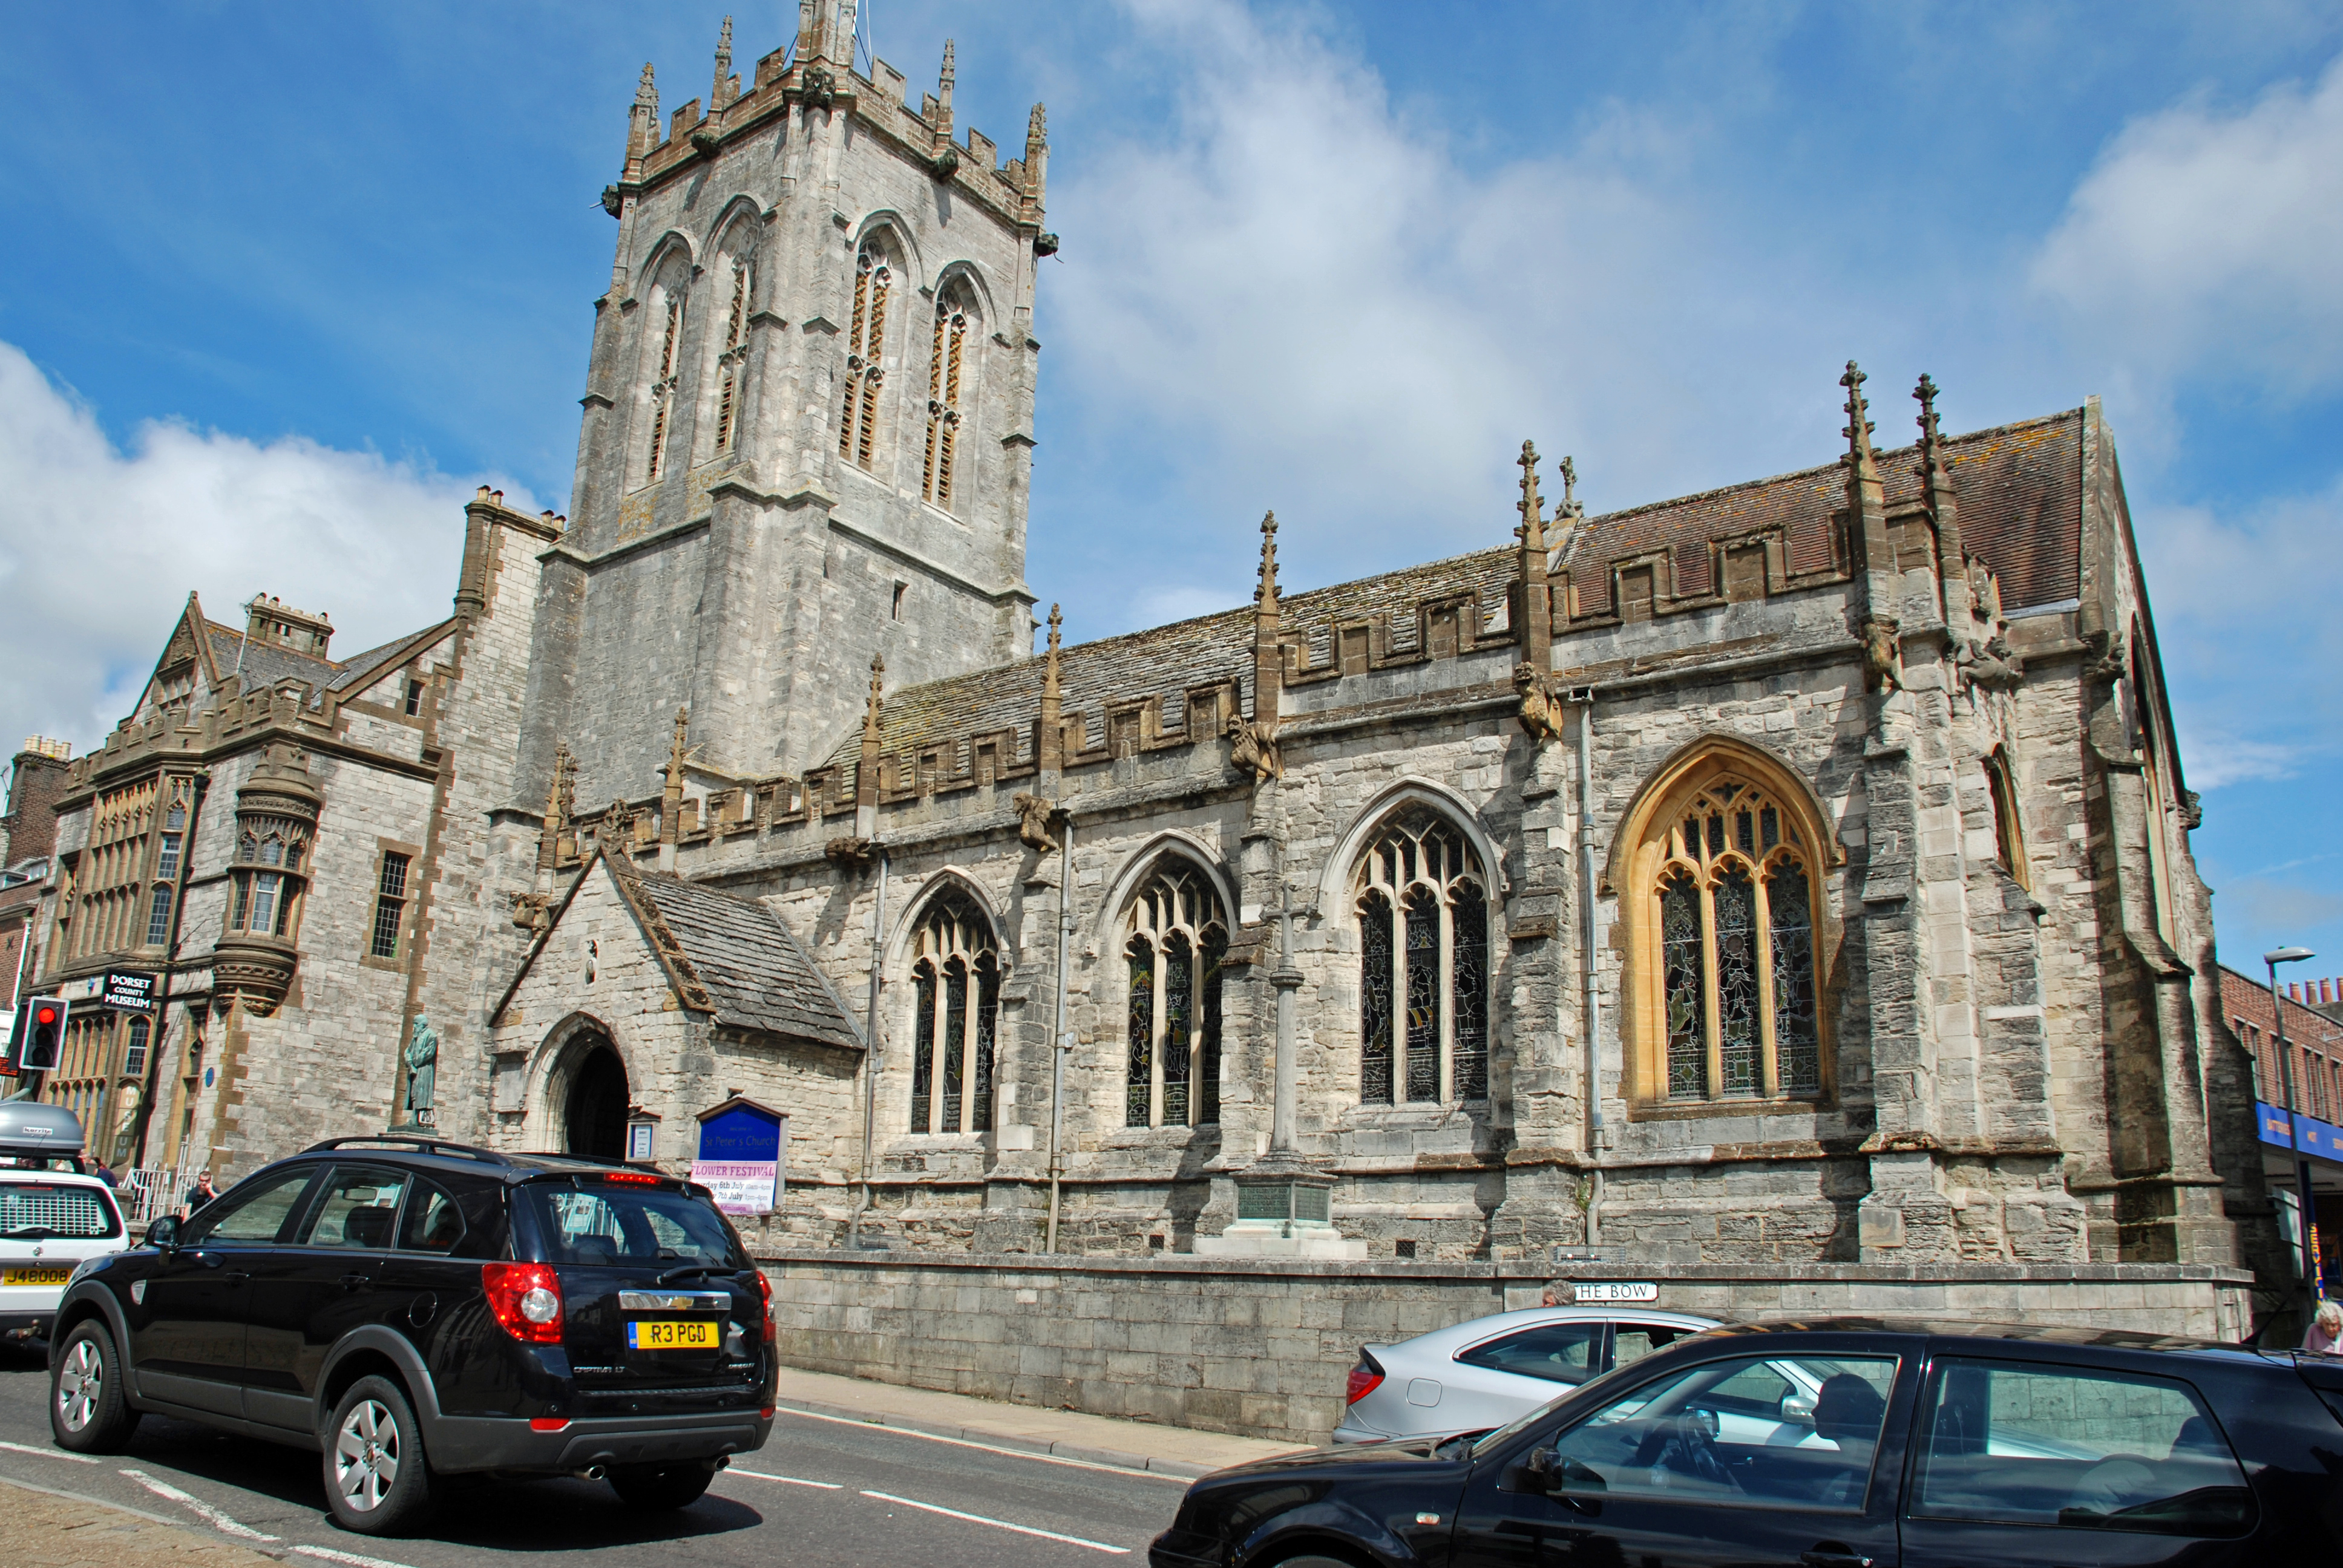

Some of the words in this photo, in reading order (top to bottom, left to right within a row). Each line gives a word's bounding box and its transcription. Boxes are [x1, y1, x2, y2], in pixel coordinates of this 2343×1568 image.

[111, 975, 151, 988] DORSET
[114, 986, 145, 996] COUNTY
[105, 993, 151, 1008] MUSEUM
[116, 1086, 137, 1157] MUSEUM
[705, 1136, 713, 1147] St
[746, 1135, 776, 1146] Church
[692, 1166, 727, 1176] FLOWER
[730, 1166, 774, 1177] FESTIVAL
[729, 1192, 743, 1201] July
[1611, 1285, 1647, 1298] BOW
[652, 1324, 673, 1343] R3
[678, 1324, 706, 1342] PGD
